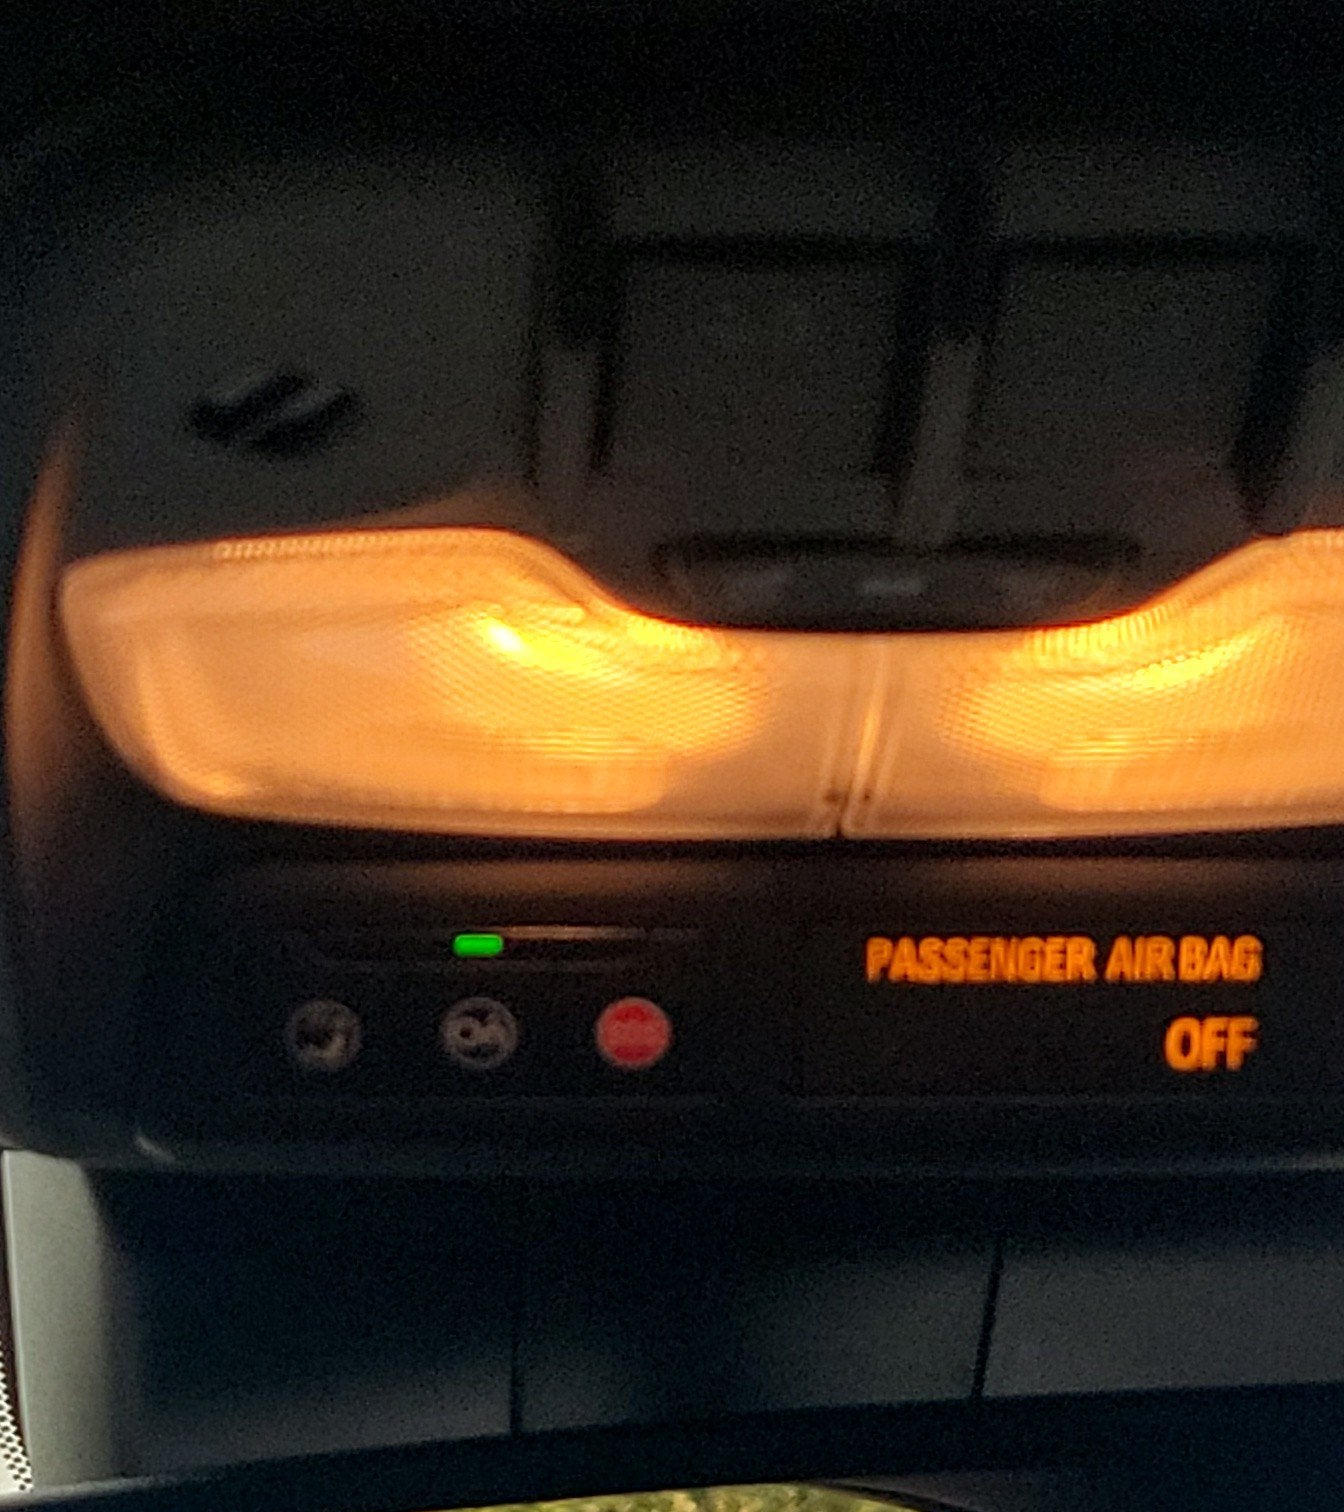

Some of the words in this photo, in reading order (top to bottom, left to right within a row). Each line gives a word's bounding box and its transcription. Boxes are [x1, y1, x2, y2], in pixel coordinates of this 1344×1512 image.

[865, 935, 1097, 983] PASSENGER
[1104, 935, 1176, 983] AIR
[1178, 935, 1264, 983] BAG
[1164, 1016, 1258, 1070] OFF
